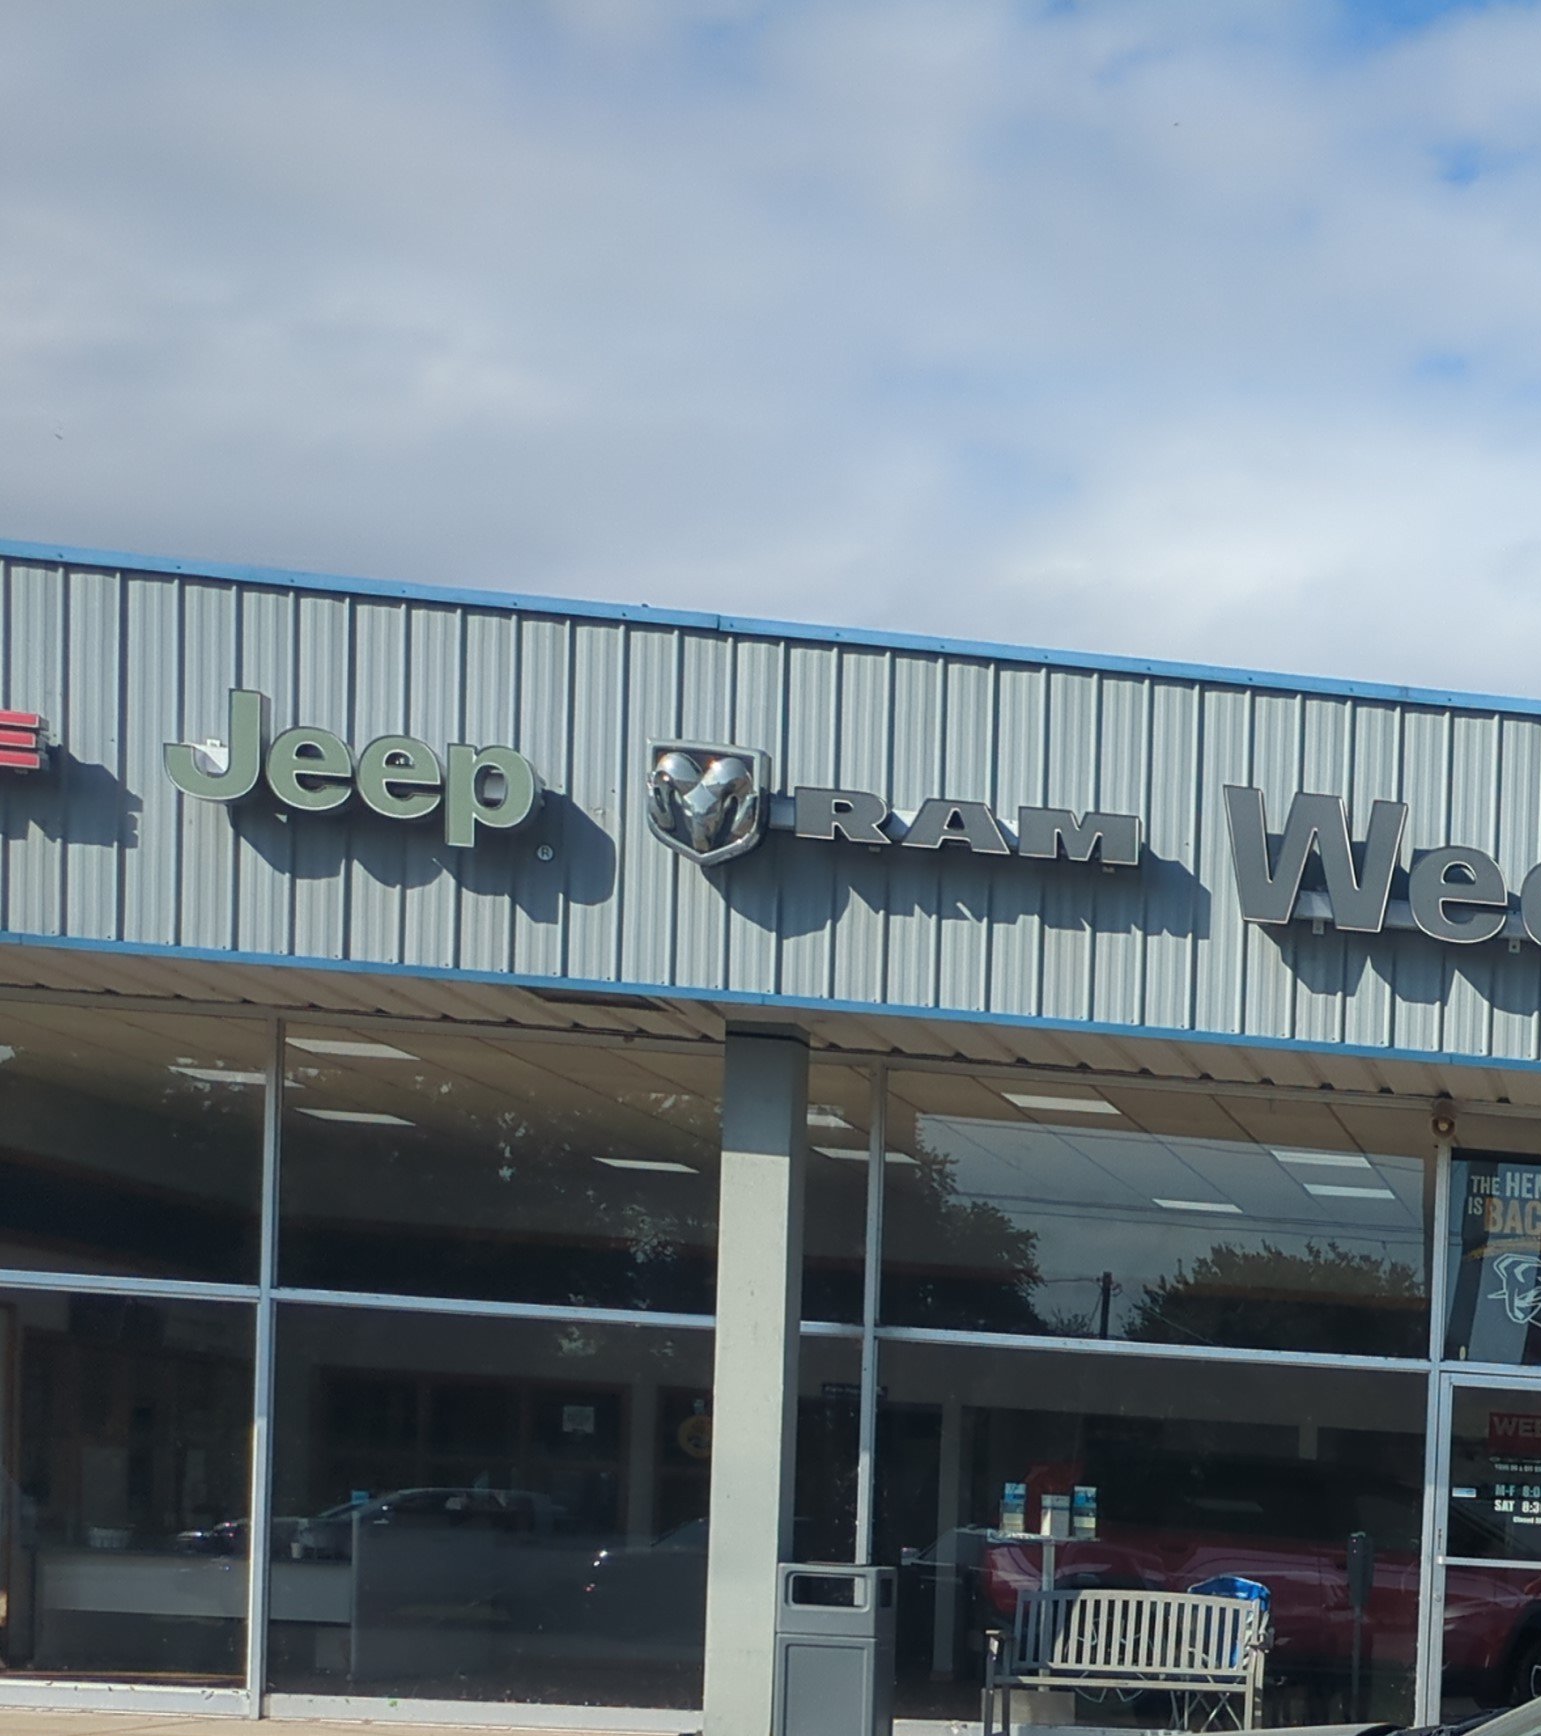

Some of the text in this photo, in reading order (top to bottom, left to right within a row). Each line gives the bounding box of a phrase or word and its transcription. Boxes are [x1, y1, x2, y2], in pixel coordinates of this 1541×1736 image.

[164, 688, 542, 848] Jeep
[793, 785, 1141, 867] RAM
[1471, 1175, 1500, 1195] THE
[1468, 1196, 1483, 1215] IS
[1495, 1484, 1516, 1497] M-F
[1494, 1499, 1515, 1512] SAT
